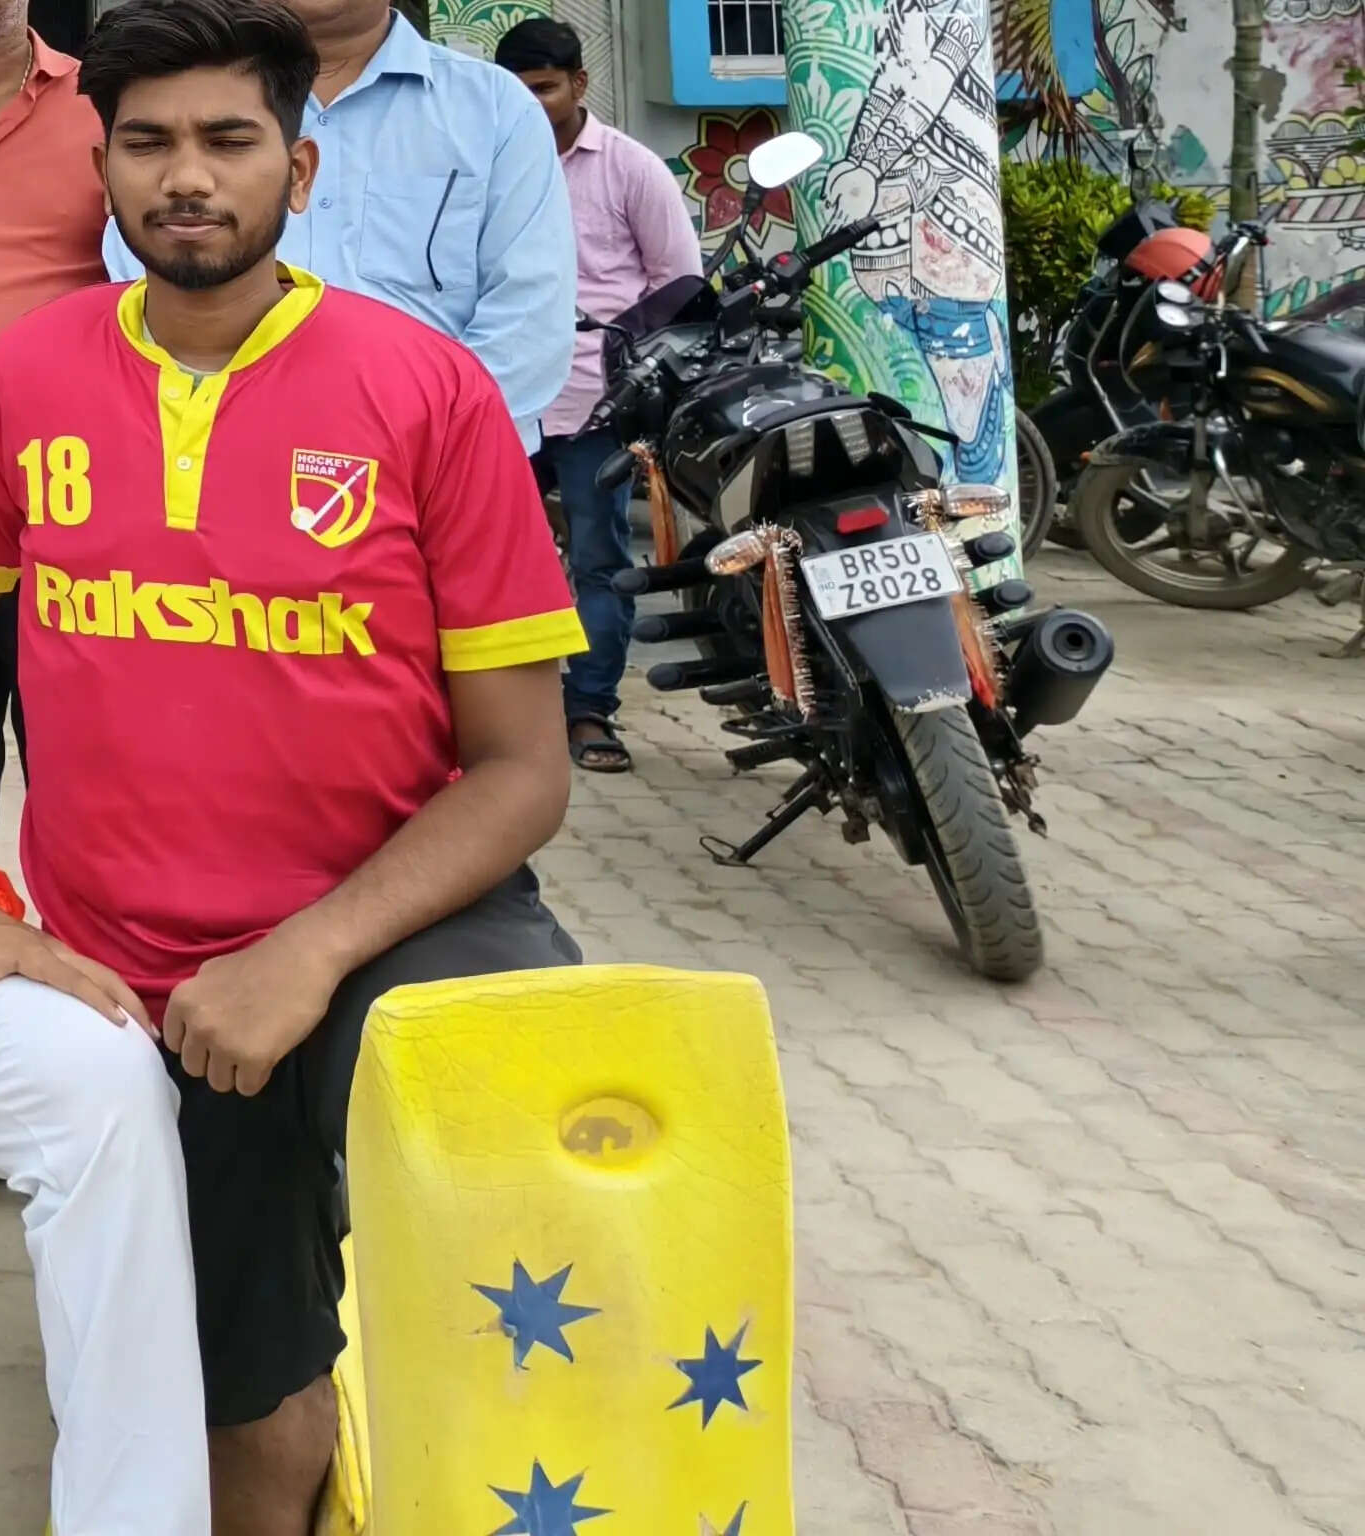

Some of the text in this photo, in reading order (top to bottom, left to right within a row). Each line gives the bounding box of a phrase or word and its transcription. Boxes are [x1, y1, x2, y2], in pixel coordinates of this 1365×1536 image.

[17, 435, 92, 526] 18
[296, 463, 337, 477] BIHAR
[297, 453, 352, 469] HOCKEY
[840, 541, 921, 579] BR50
[34, 561, 376, 656] Rakshak
[839, 568, 942, 610] Z8028
